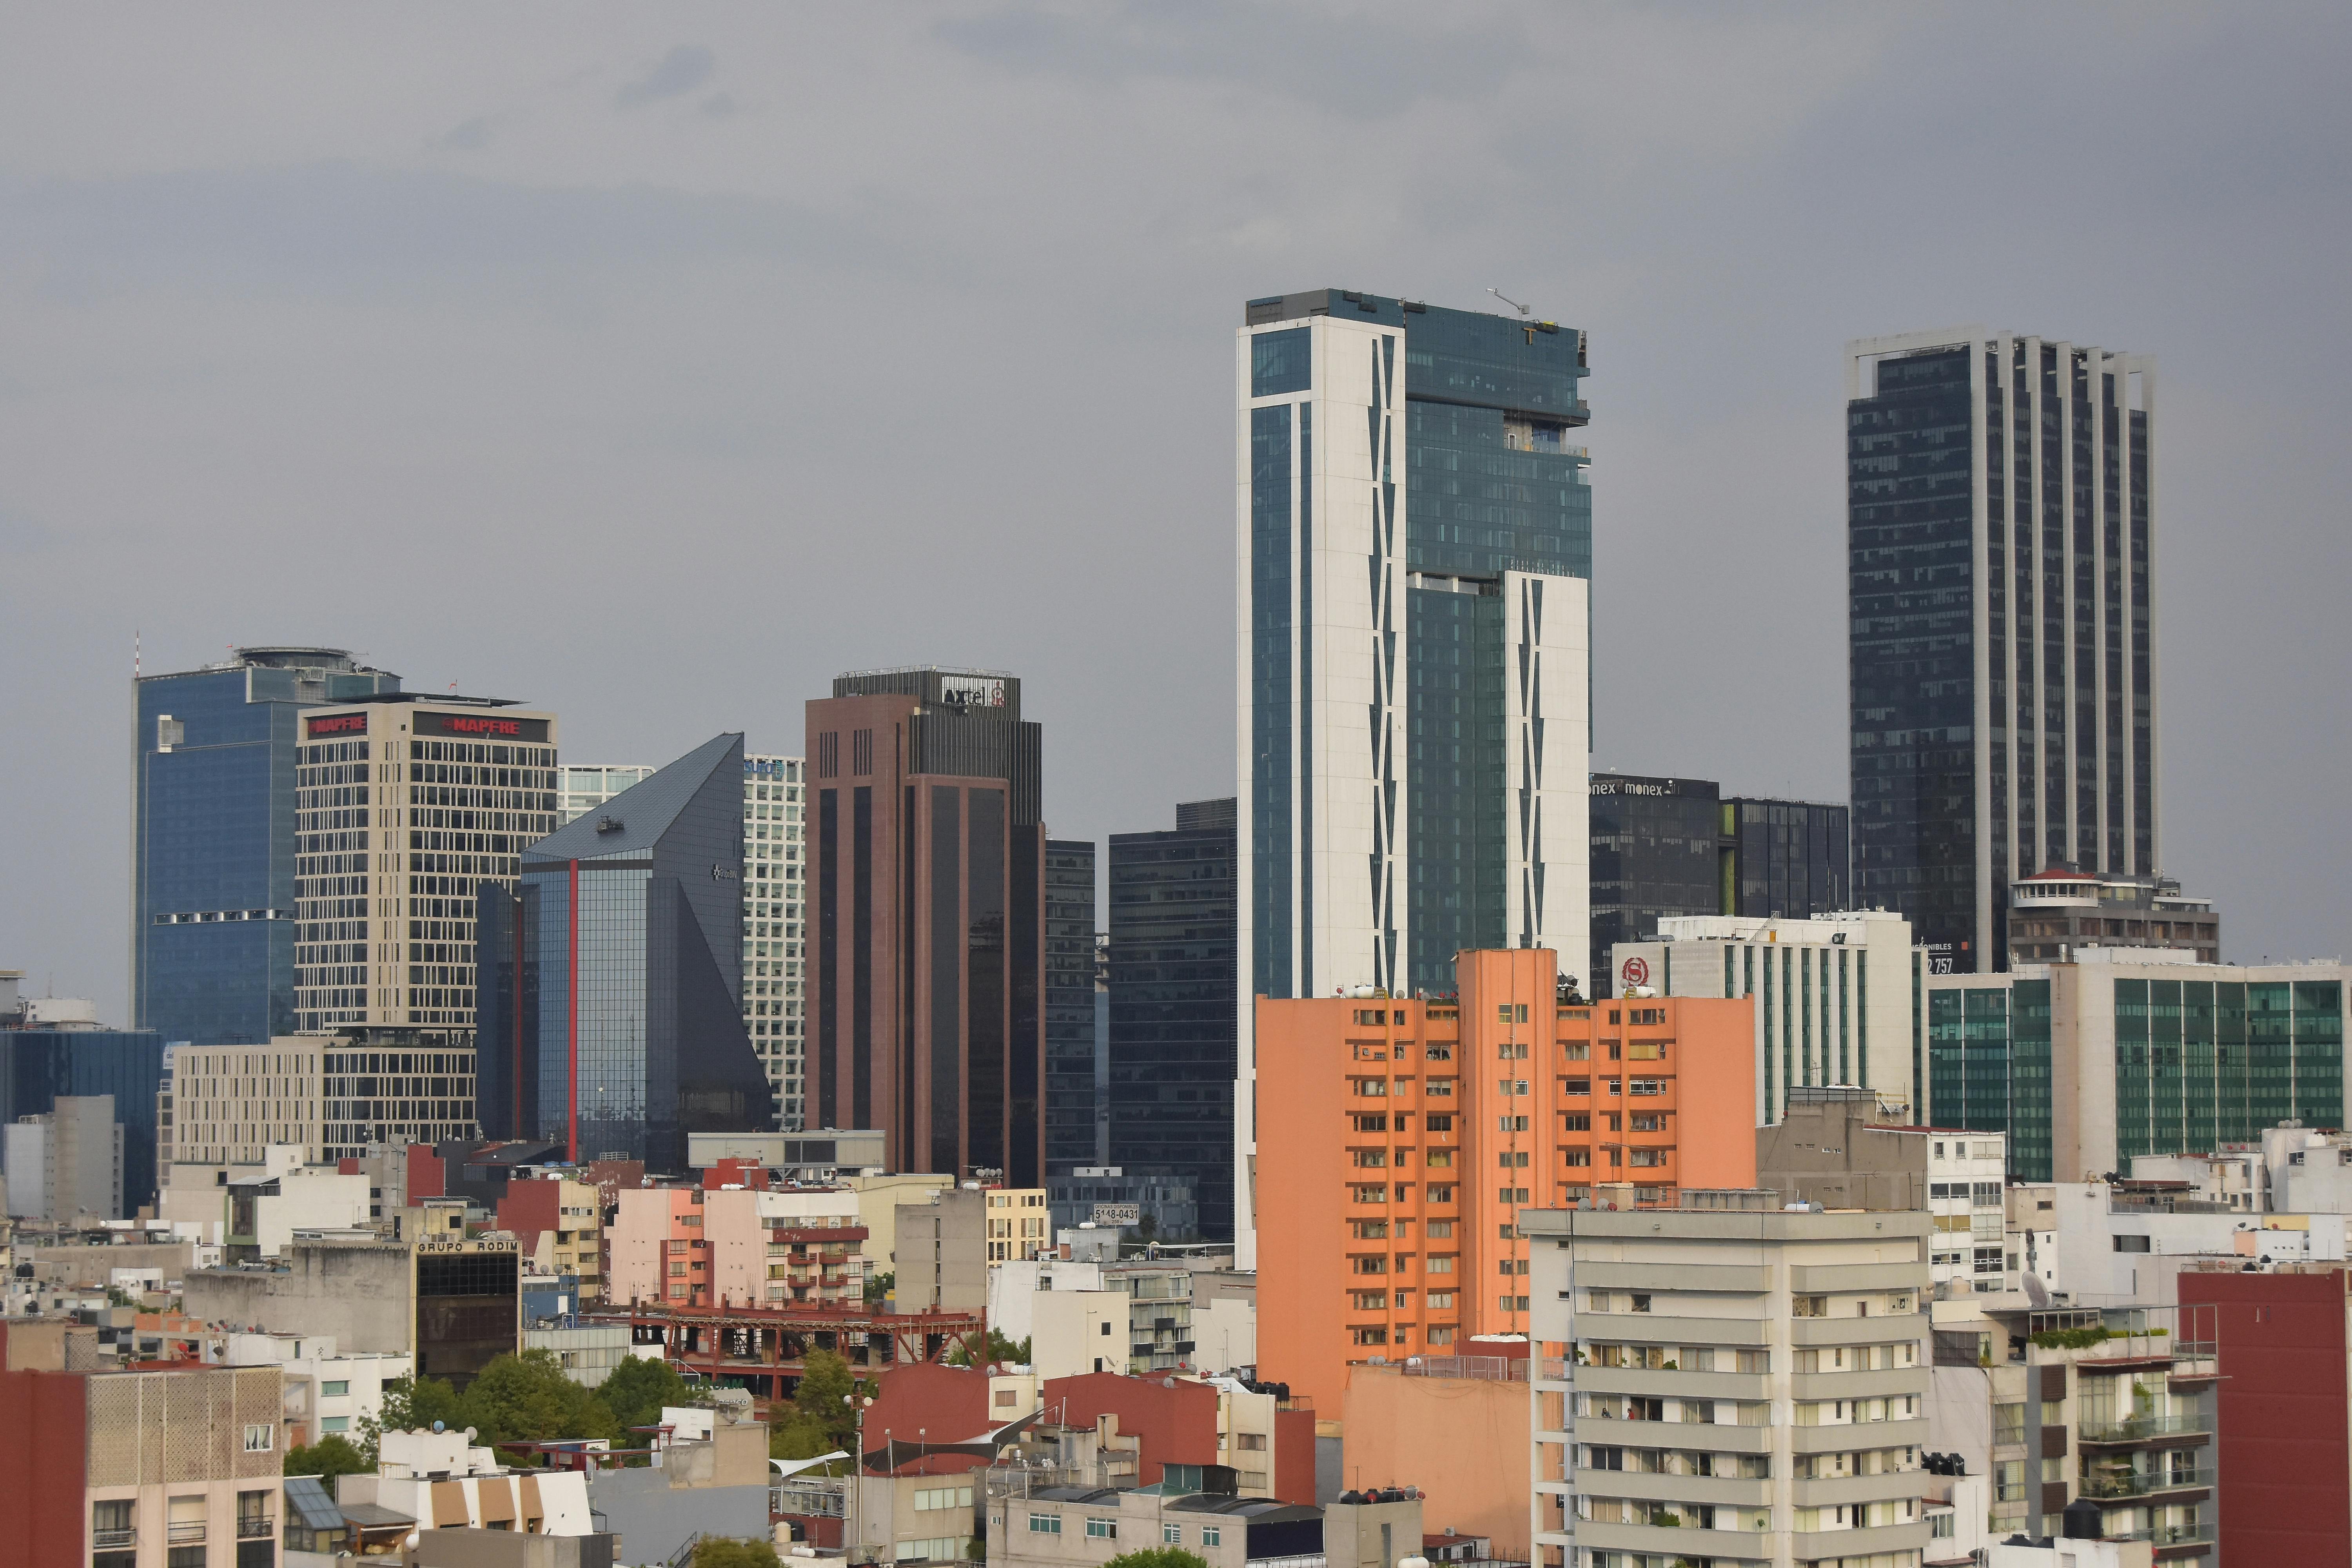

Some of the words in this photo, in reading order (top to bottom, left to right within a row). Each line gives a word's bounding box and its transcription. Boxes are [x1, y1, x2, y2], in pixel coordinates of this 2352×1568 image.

[316, 716, 365, 733] MAPFRE
[454, 719, 520, 735] MAPFRE
[1625, 784, 1662, 796] monex
[1935, 958, 1952, 974] 757
[418, 1243, 463, 1252] GRUPO
[478, 1242, 517, 1251] RODIM
